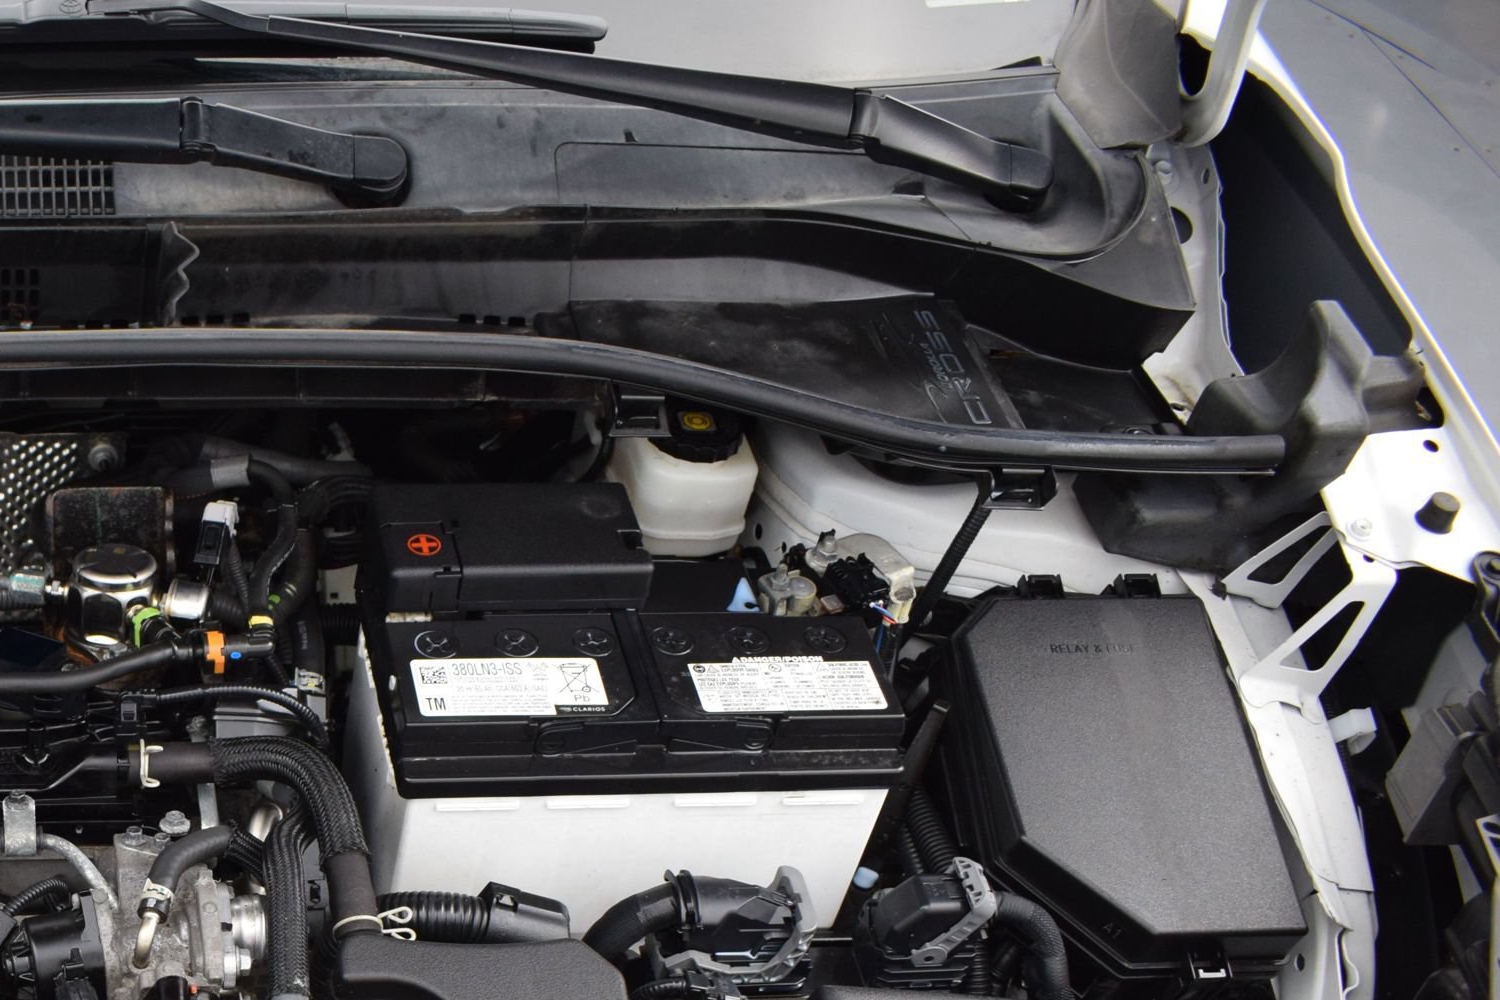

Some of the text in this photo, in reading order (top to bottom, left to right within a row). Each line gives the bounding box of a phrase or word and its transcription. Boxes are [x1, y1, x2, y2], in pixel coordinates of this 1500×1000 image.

[1049, 644, 1089, 654] RELAY
[1093, 644, 1102, 654] &
[452, 662, 523, 676] 380LN3-ISS
[425, 697, 447, 711] TM
[573, 694, 591, 703] Pb
